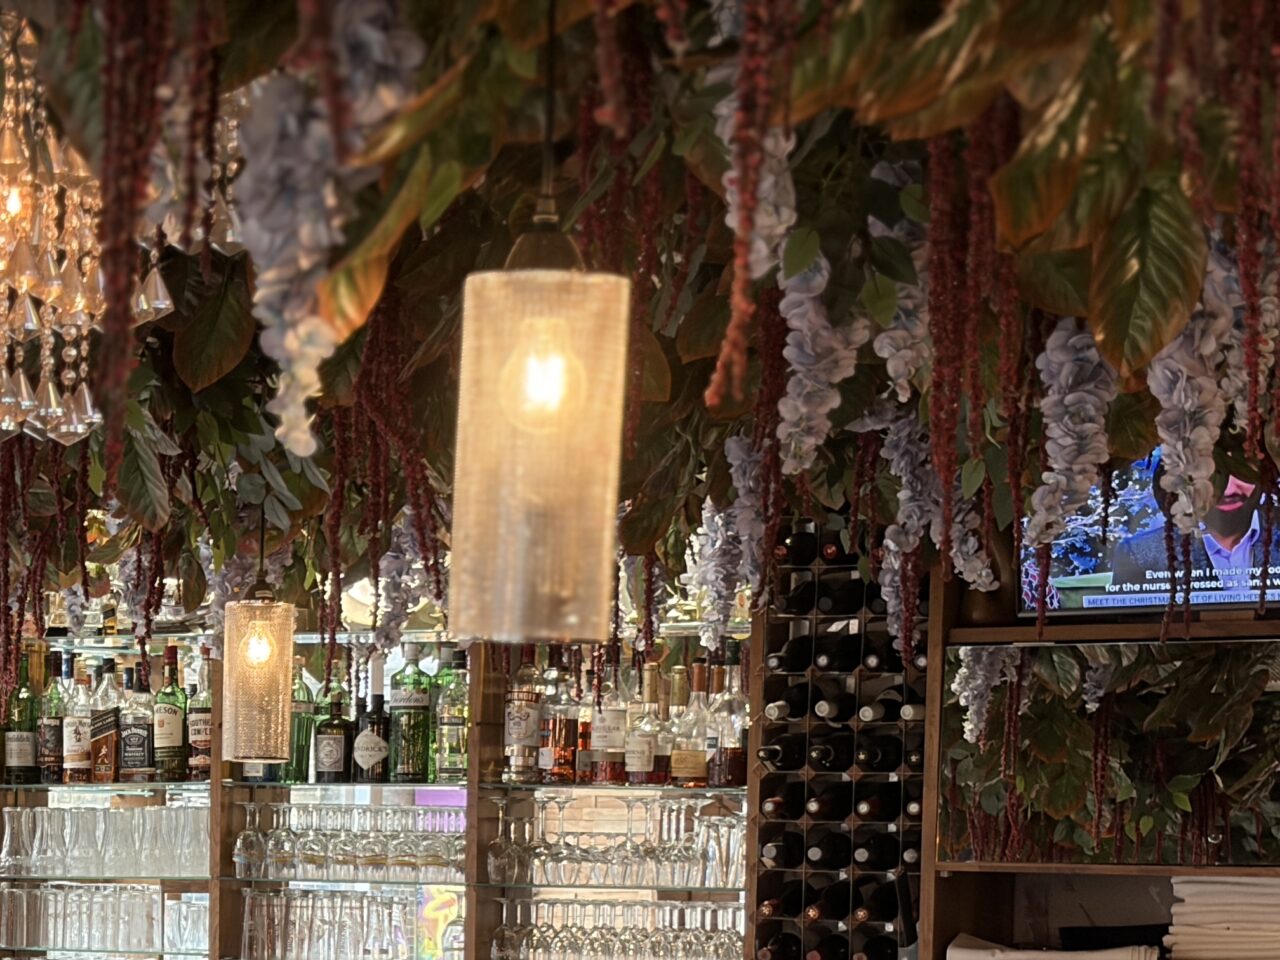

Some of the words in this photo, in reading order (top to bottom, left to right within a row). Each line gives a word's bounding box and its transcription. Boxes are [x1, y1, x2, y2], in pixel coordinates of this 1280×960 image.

[1145, 570, 1171, 579] Even
[1174, 569, 1203, 578] wen
[1212, 566, 1242, 577] made
[1245, 567, 1262, 577] my
[1105, 582, 1120, 592] for
[1122, 582, 1140, 591] the
[1226, 579, 1238, 587] as
[1087, 598, 1108, 606] MEET
[1112, 597, 1126, 605] THE
[1129, 595, 1170, 604] CHRISTMA
[1214, 593, 1241, 602] LIVING
